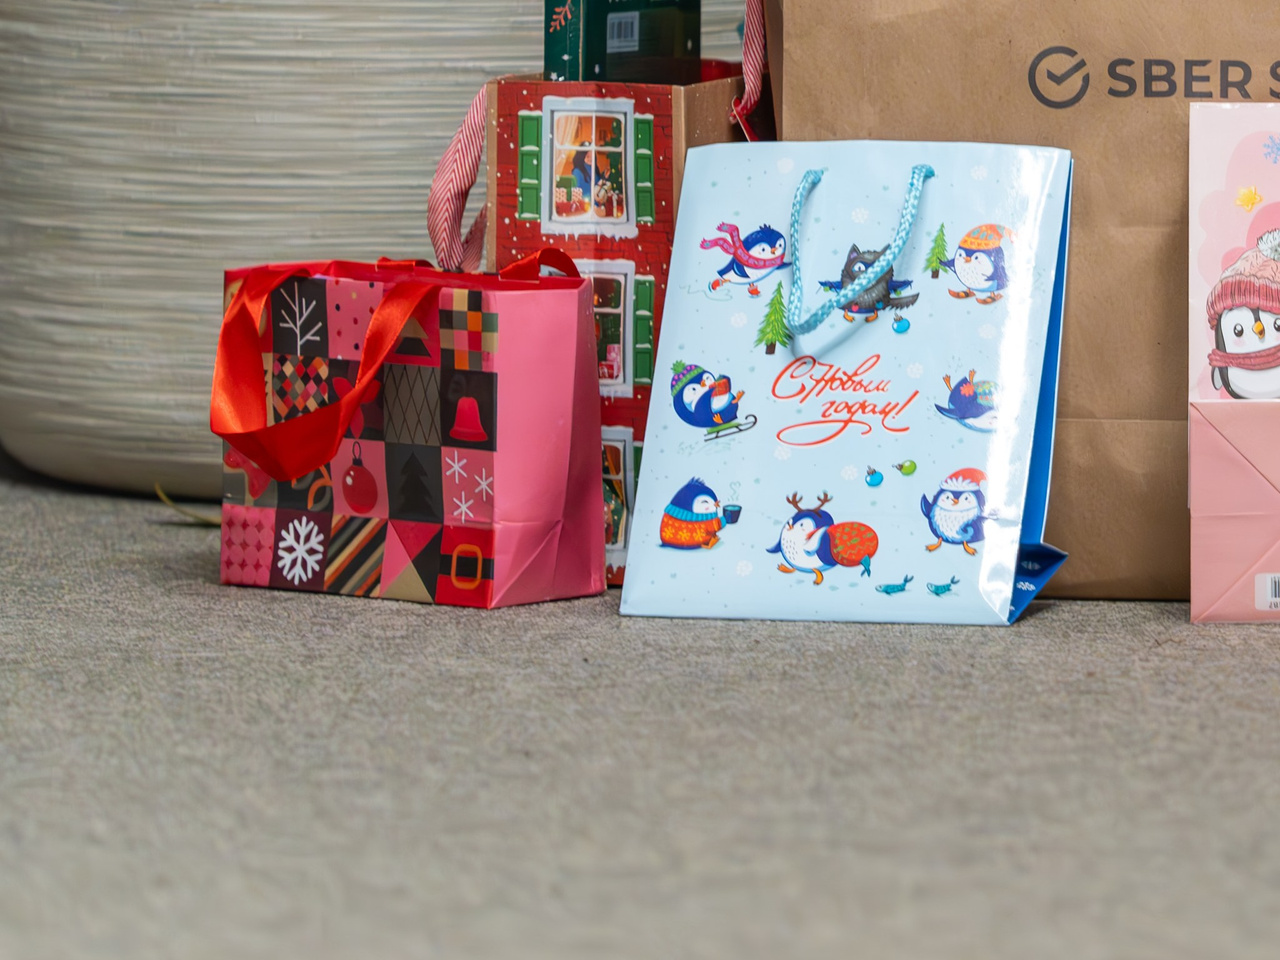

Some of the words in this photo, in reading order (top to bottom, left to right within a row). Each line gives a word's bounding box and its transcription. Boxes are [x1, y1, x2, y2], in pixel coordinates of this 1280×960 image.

[1106, 57, 1252, 99] SBER
[800, 353, 892, 404] Новым
[776, 390, 920, 447] годам!
